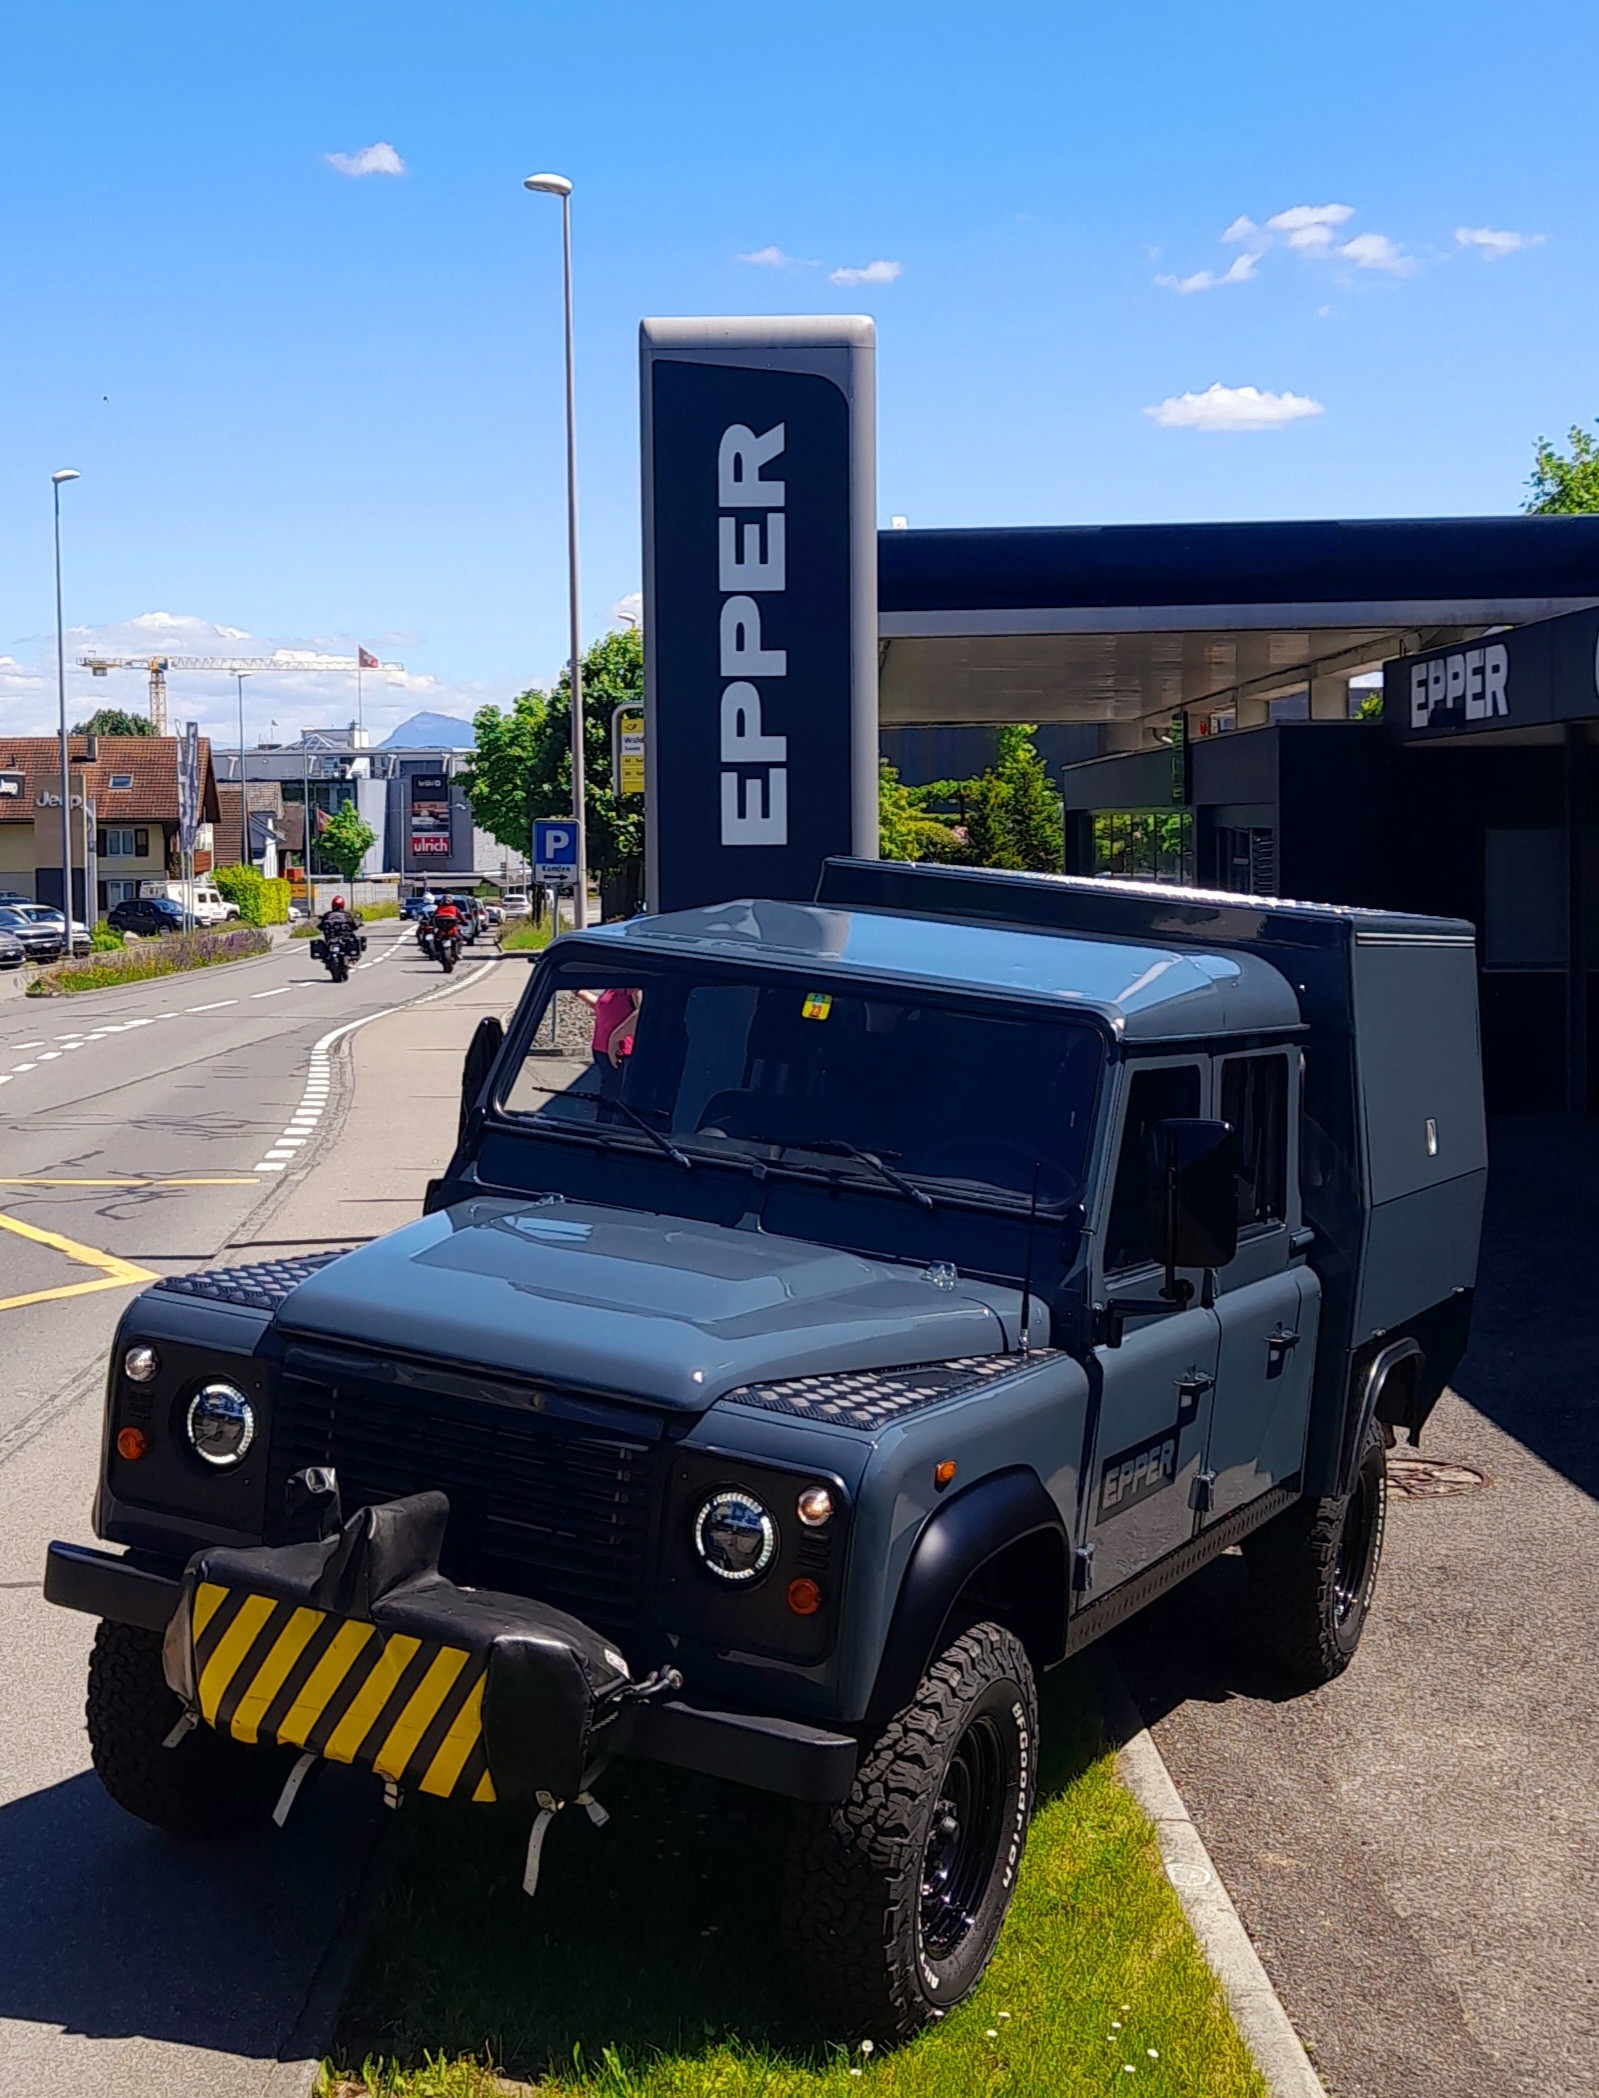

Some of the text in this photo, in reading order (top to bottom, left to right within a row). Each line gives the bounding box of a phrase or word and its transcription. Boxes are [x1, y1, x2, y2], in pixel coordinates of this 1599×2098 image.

[718, 421, 788, 846] EPPER
[1411, 643, 1509, 729] EPPER
[36, 790, 82, 809] Jep
[414, 837, 448, 852] ulrich
[546, 829, 570, 859] P
[1102, 1438, 1175, 1511] EPPER
